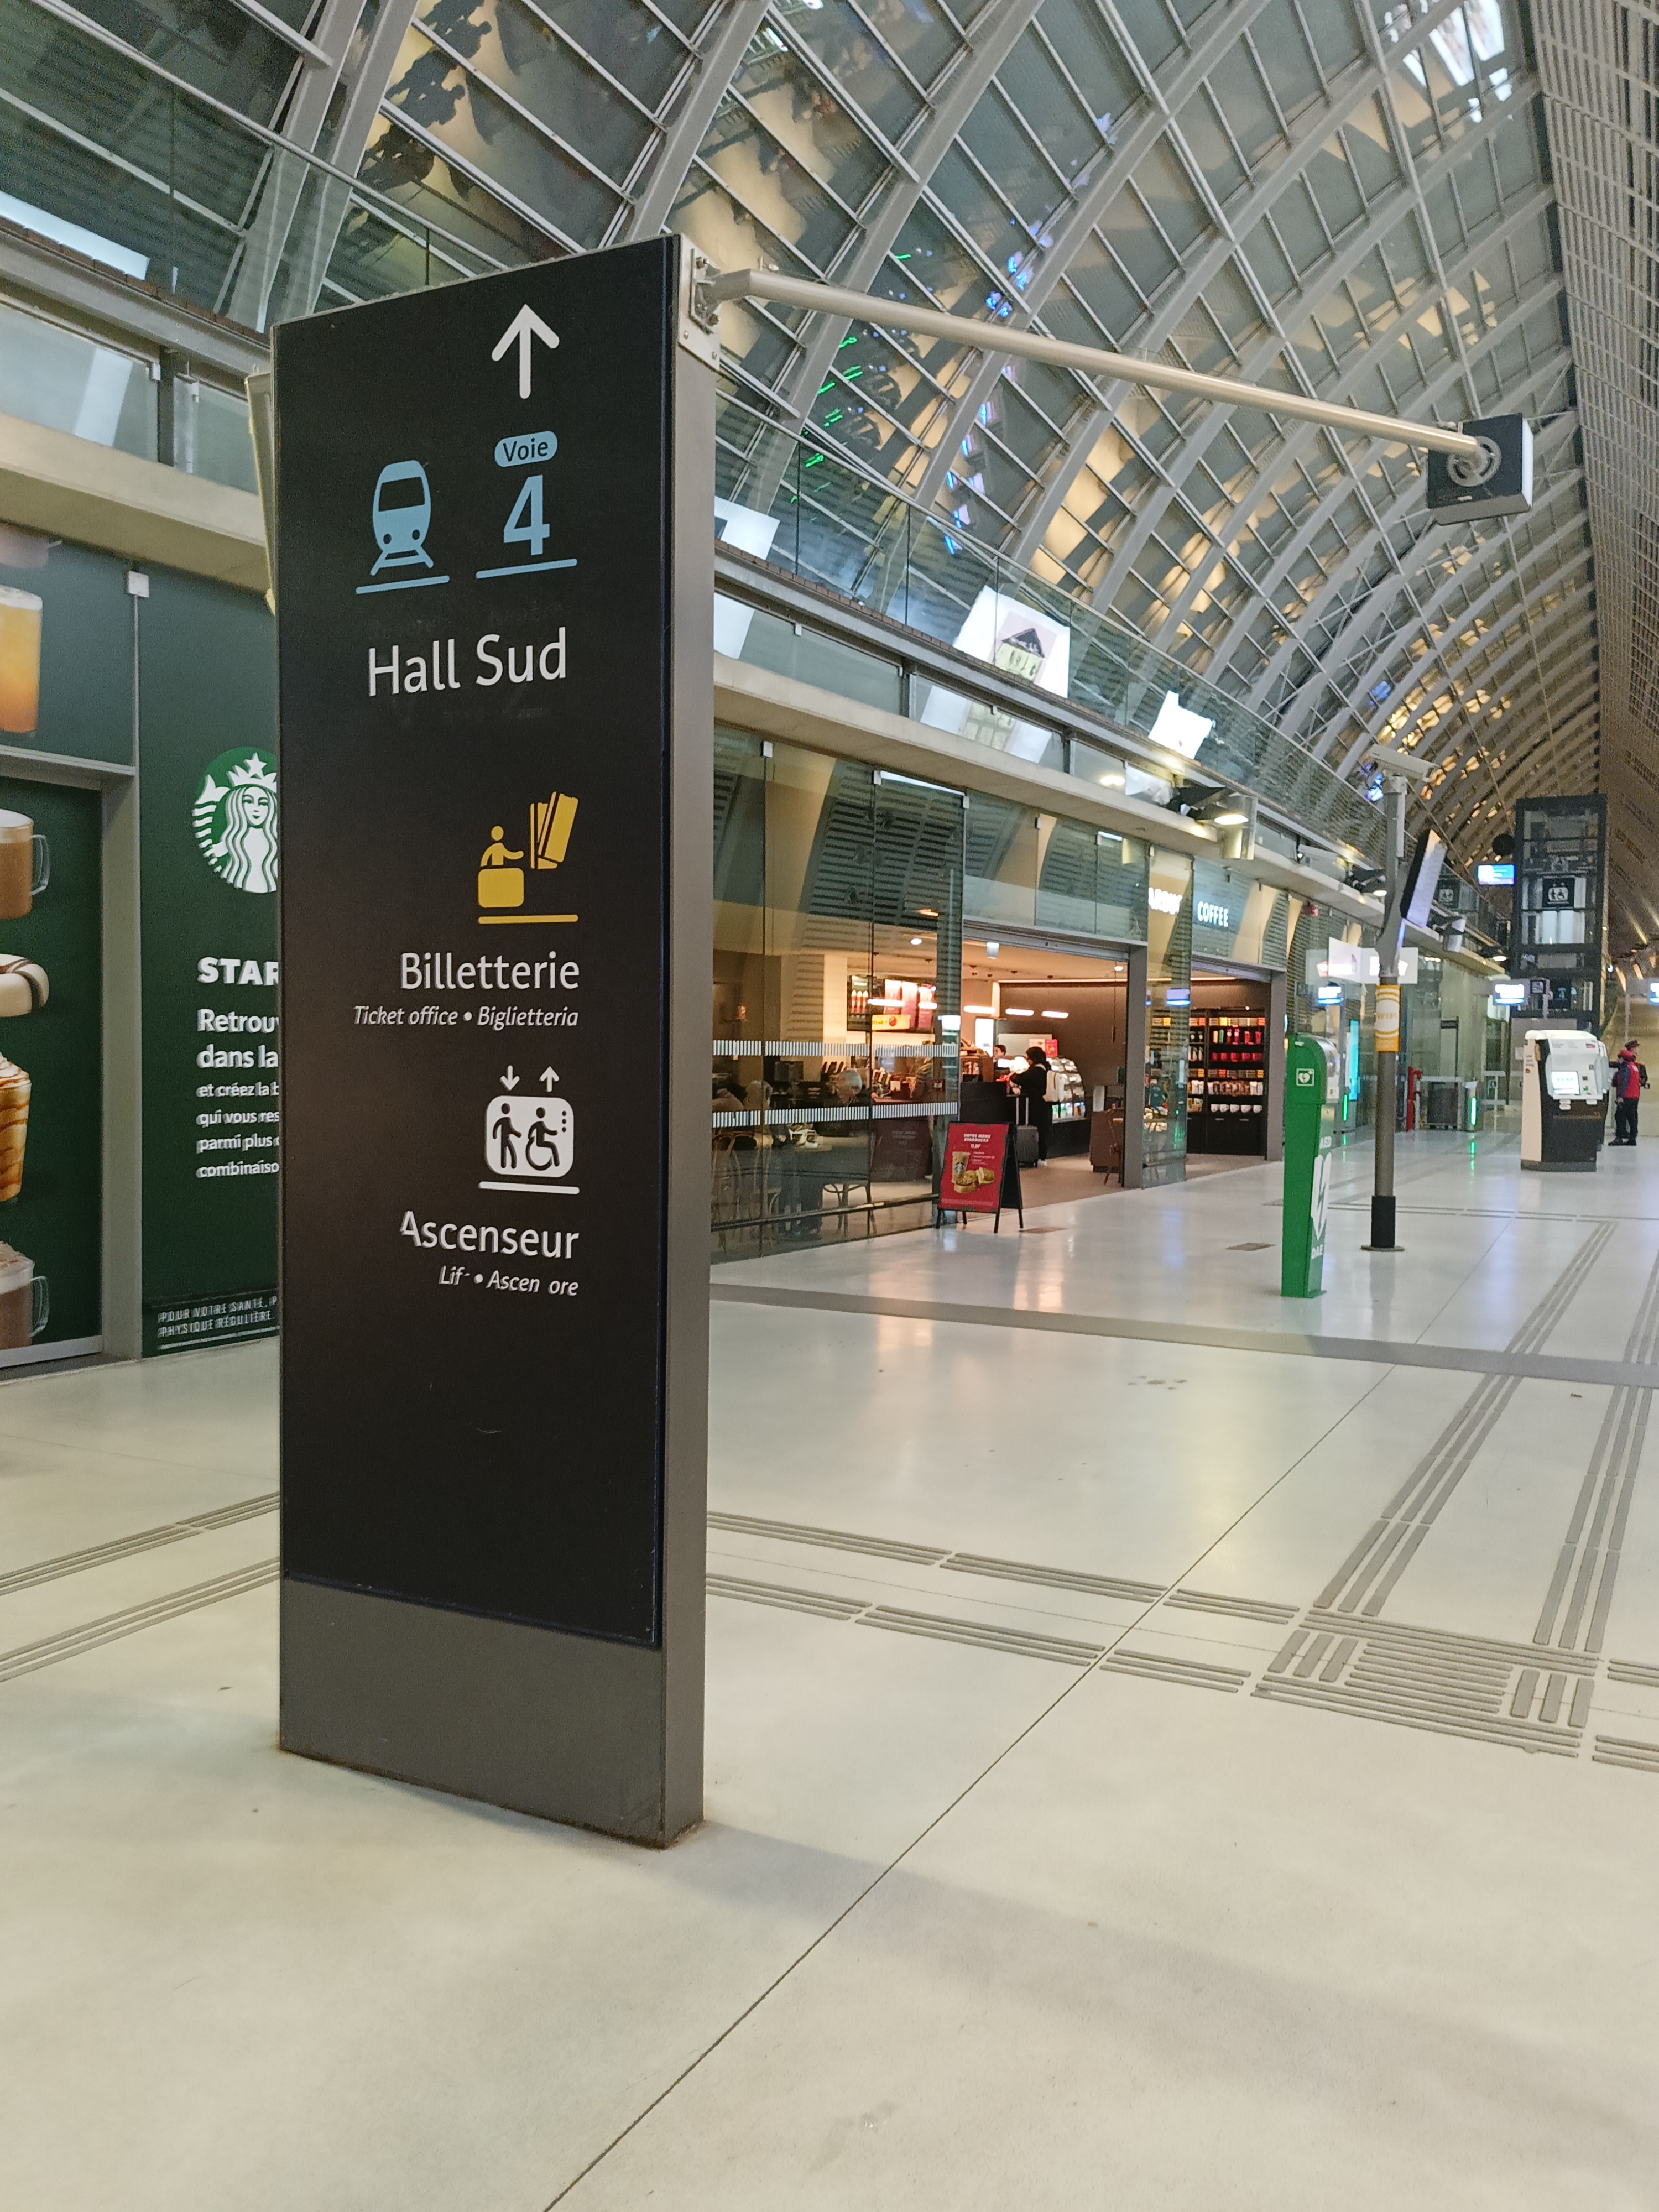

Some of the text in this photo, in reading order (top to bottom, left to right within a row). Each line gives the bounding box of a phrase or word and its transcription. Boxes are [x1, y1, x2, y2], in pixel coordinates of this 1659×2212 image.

[502, 437, 549, 462] Voie
[503, 474, 550, 556] 4
[368, 626, 566, 697] Hall Sud
[1197, 901, 1229, 927] COFFEE
[400, 951, 580, 990] Billetterie
[353, 1005, 579, 1031] Ticket office Biglietteria
[196, 1044, 278, 1068] dans la
[196, 1083, 214, 1097] et
[215, 1082, 255, 1097] créez
[255, 1081, 269, 1096] la
[196, 1109, 222, 1128] qui
[223, 1112, 257, 1124] vous
[196, 1134, 241, 1154] parmi
[242, 1133, 273, 1152] plus
[400, 1210, 580, 1259] Ascenseur
[439, 1265, 579, 1296] Lif Ascenore
[158, 1308, 190, 1323] POUR
[192, 1303, 227, 1318] VOTRE
[158, 1319, 213, 1338] PHYSIQUE
